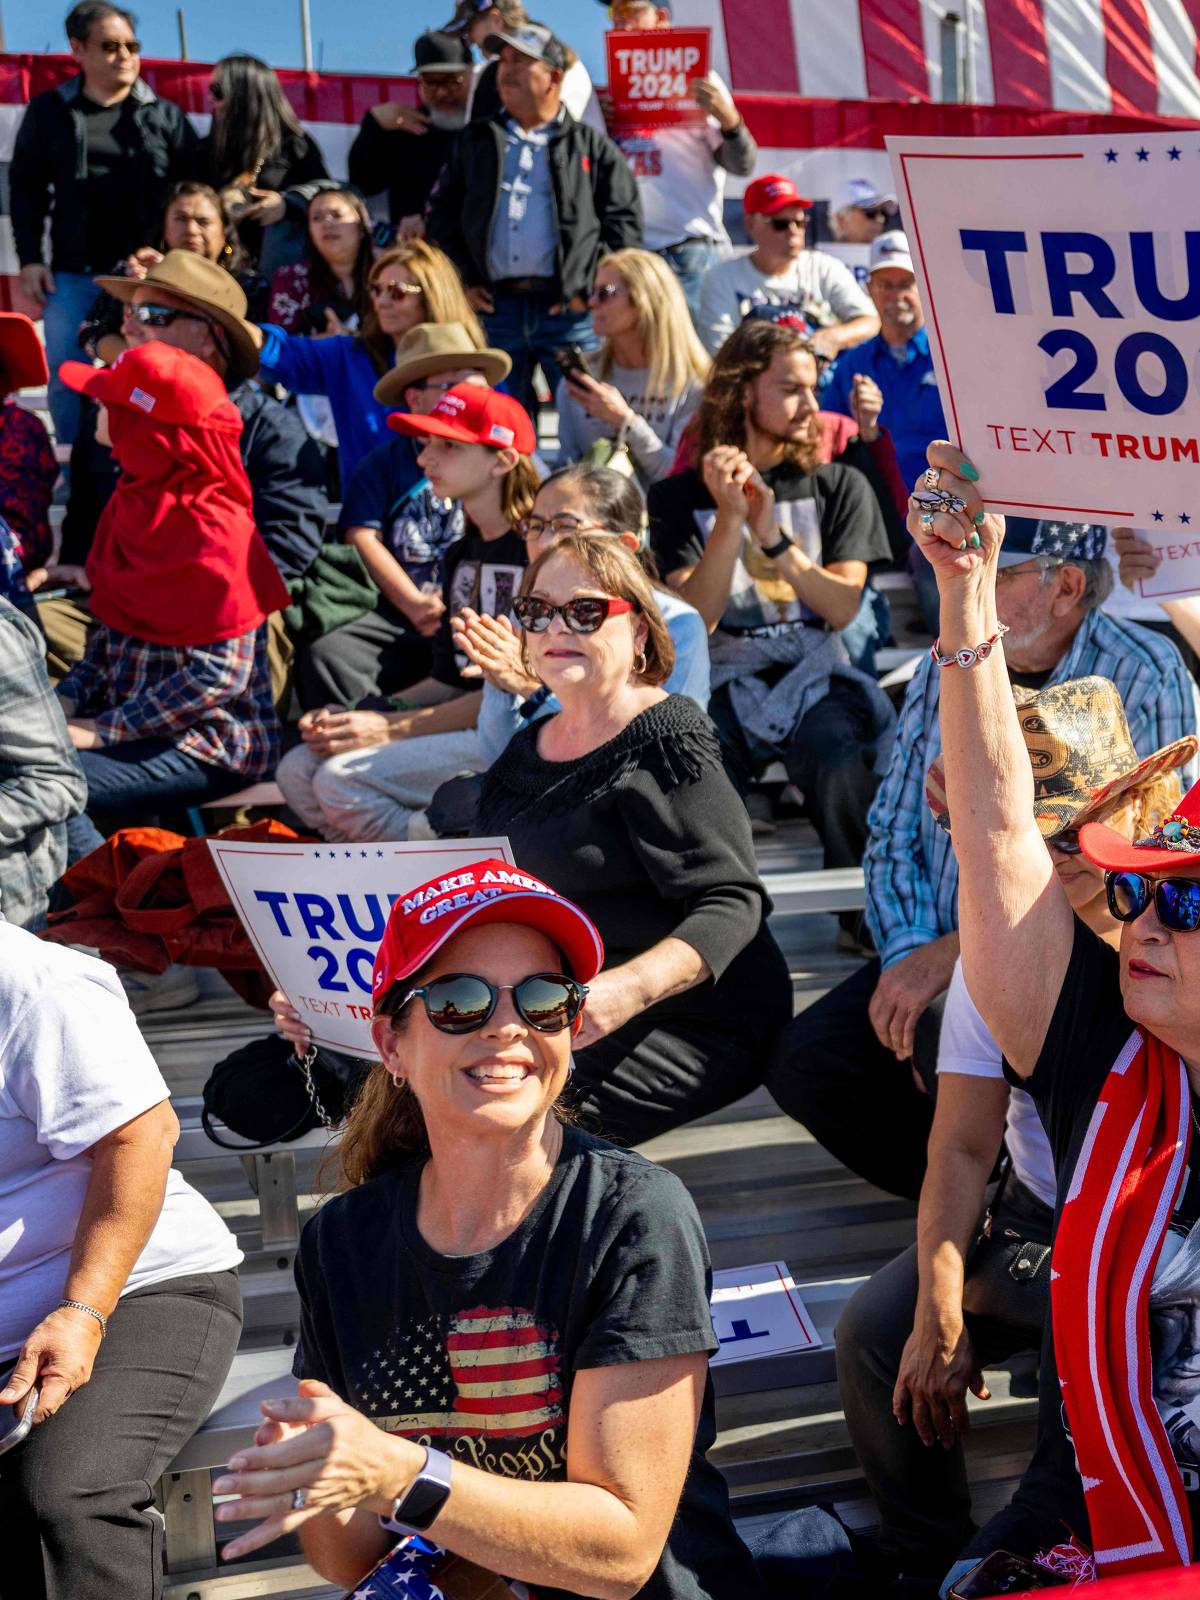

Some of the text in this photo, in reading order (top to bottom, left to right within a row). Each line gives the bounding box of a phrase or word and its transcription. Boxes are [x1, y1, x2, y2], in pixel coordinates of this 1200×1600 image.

[615, 47, 700, 75] TRUMP
[628, 74, 687, 98] 2024
[987, 424, 1077, 456] TEXT
[401, 873, 475, 915] MAKE
[419, 887, 503, 925] GREAT
[299, 996, 341, 1017] TEXT
